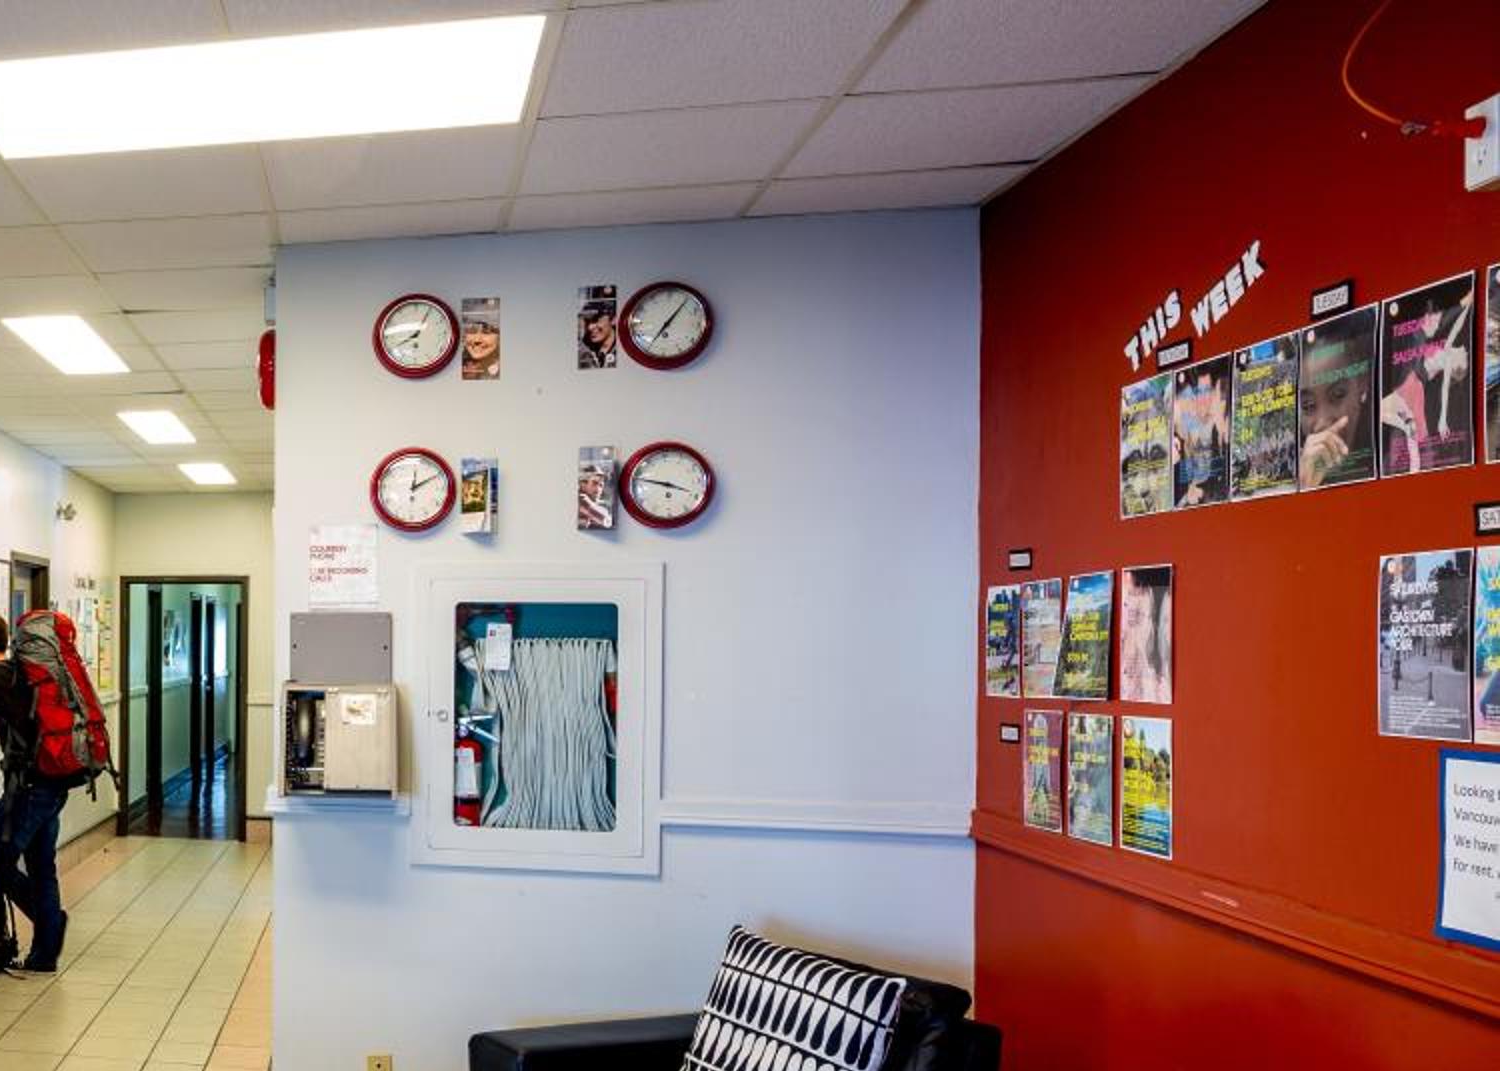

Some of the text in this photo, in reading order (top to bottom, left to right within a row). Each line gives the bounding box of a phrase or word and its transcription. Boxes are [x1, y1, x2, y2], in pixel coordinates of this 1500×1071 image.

[1123, 239, 1266, 373] THIS WEEK
[1389, 609, 1435, 623] GASTOWN
[1390, 622, 1453, 638] ARCHITECTURE
[1453, 783, 1495, 803] Looking
[1453, 834, 1498, 853] We have
